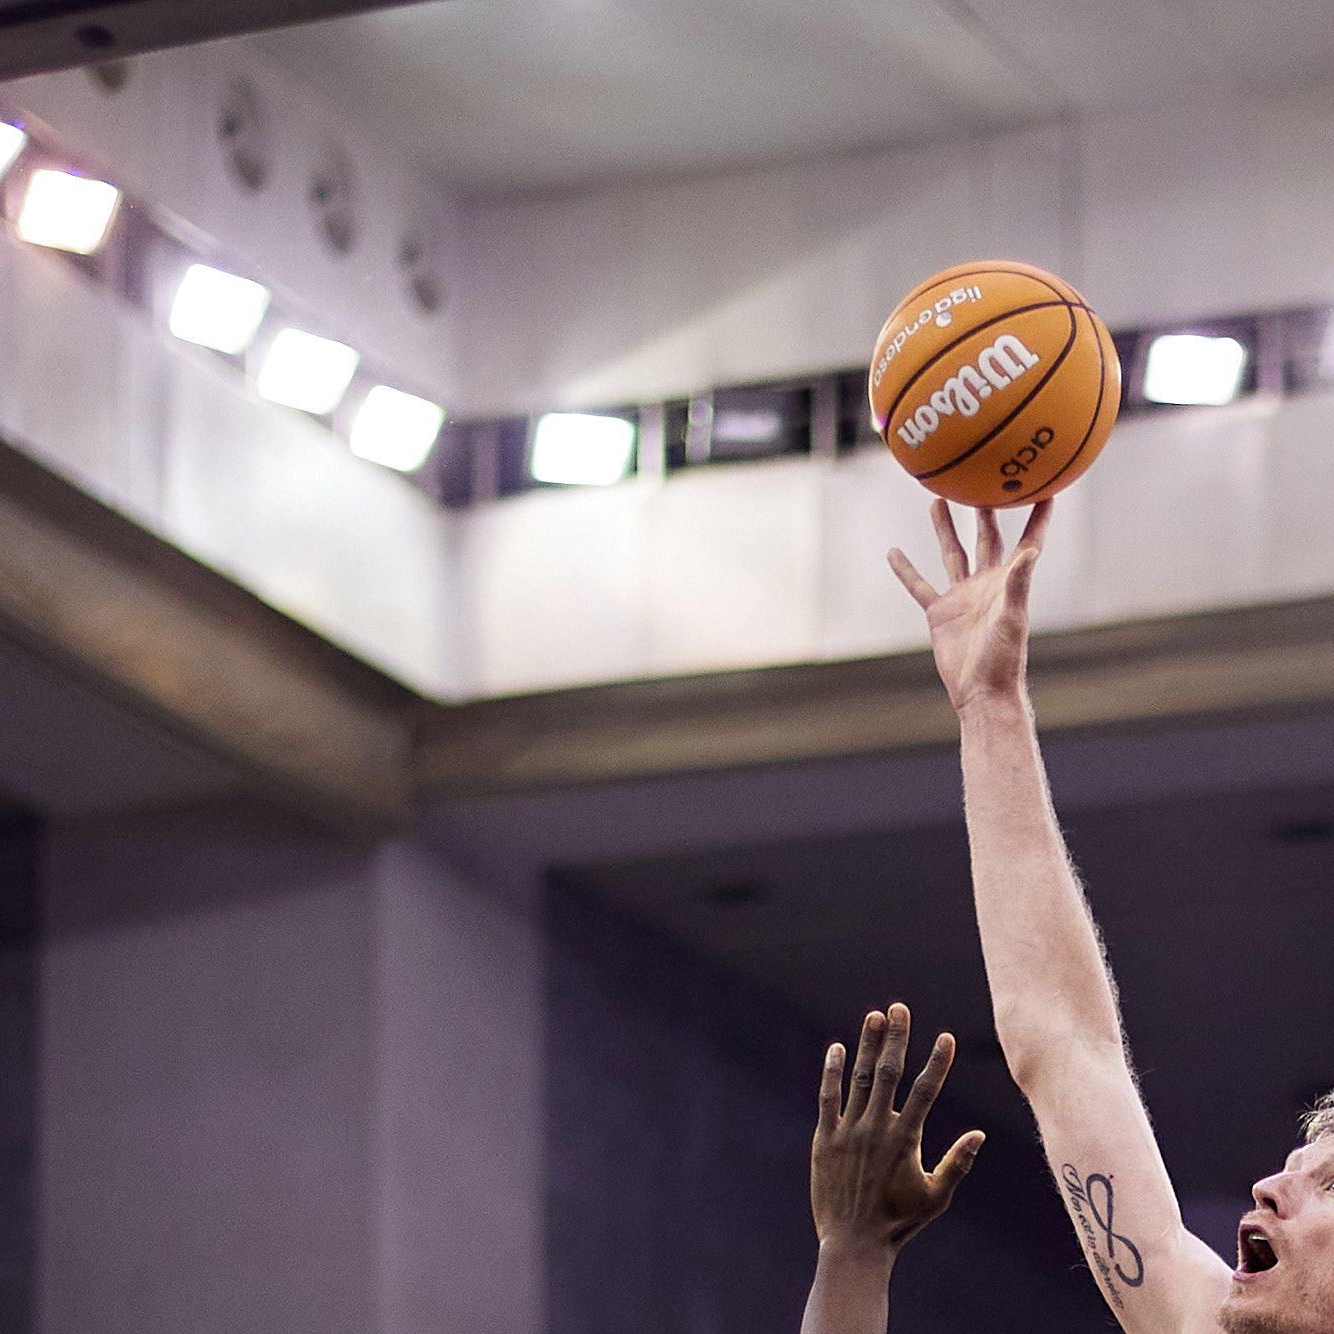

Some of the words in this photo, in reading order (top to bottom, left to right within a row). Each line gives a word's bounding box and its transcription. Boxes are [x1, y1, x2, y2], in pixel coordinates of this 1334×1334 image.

[935, 286, 983, 315] liga
[873, 308, 933, 388] endesa
[897, 334, 1041, 449] Wilson
[999, 425, 1055, 479] acb
